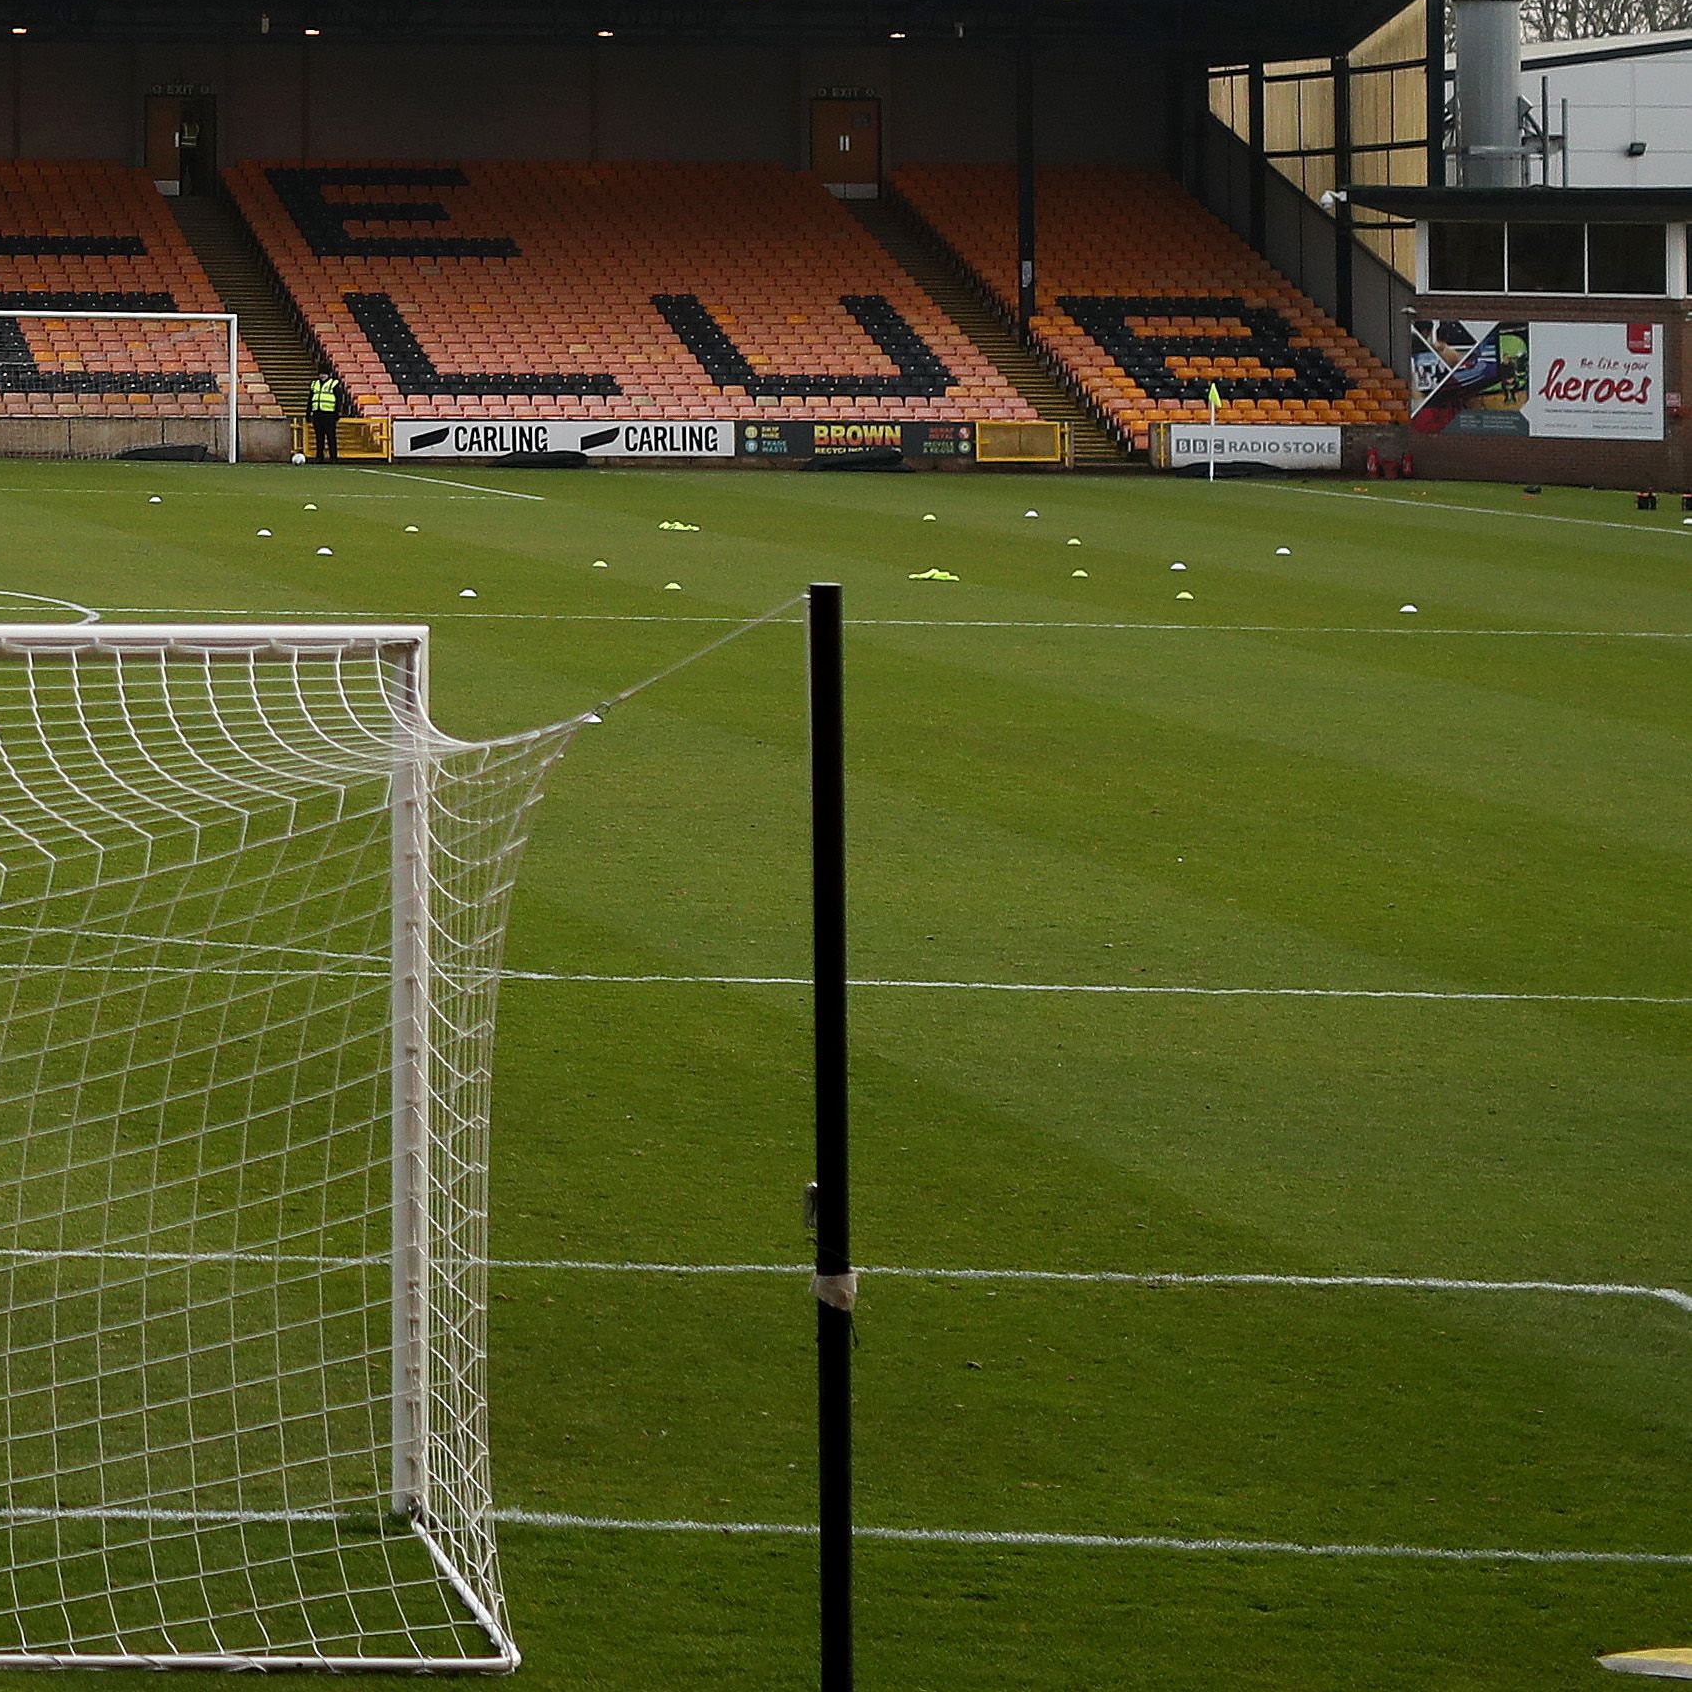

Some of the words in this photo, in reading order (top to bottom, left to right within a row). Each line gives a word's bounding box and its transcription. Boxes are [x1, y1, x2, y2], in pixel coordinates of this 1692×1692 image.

[166, 84, 194, 95] EXIT
[1623, 362, 1649, 375] your
[1538, 358, 1652, 404] heroes
[454, 426, 548, 452] CARLING
[624, 425, 718, 452] CARLING
[814, 425, 902, 446] BROWN
[1176, 439, 1225, 454] BBC
[1229, 441, 1280, 454] RADIO
[1284, 441, 1336, 454] STOKE
